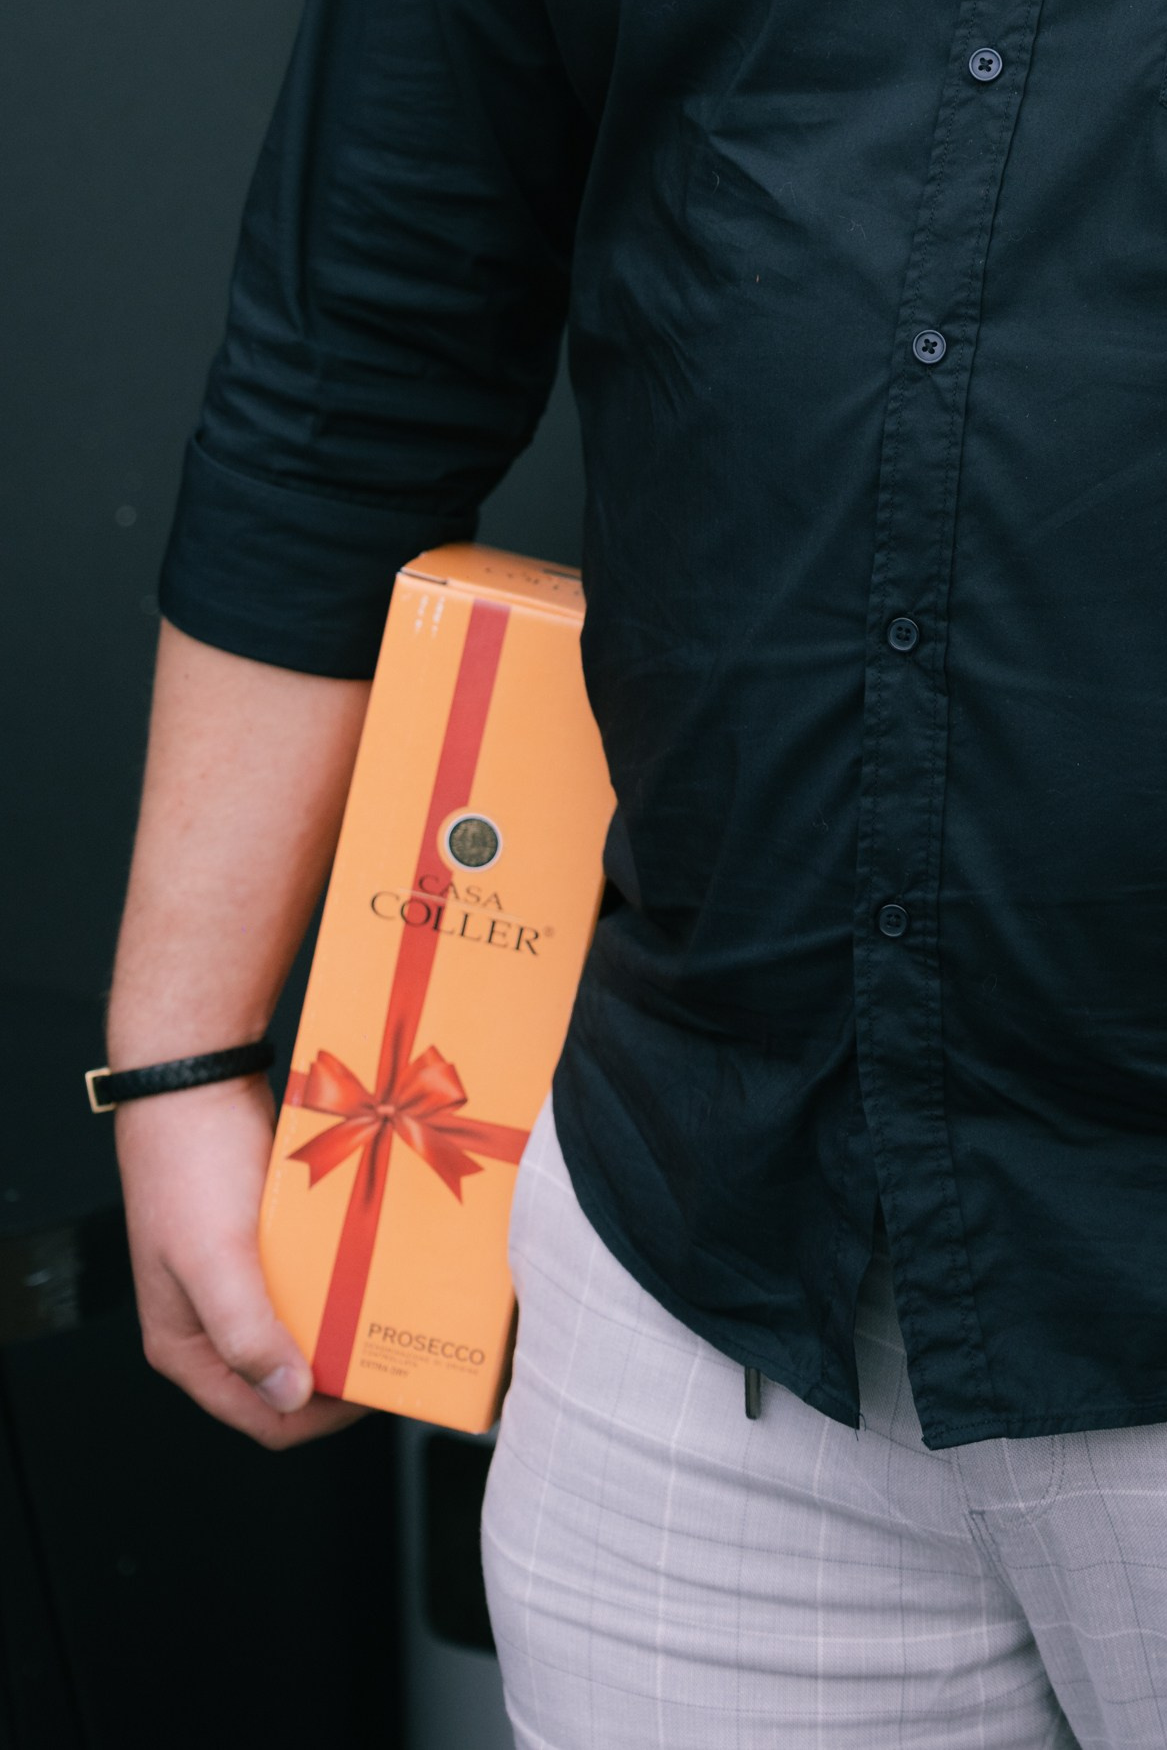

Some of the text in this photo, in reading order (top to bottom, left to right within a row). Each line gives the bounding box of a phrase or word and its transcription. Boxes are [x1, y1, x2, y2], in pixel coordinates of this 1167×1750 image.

[418, 873, 504, 911] CASA
[370, 890, 539, 956] COLLER
[368, 1322, 486, 1366] PROSECCO
